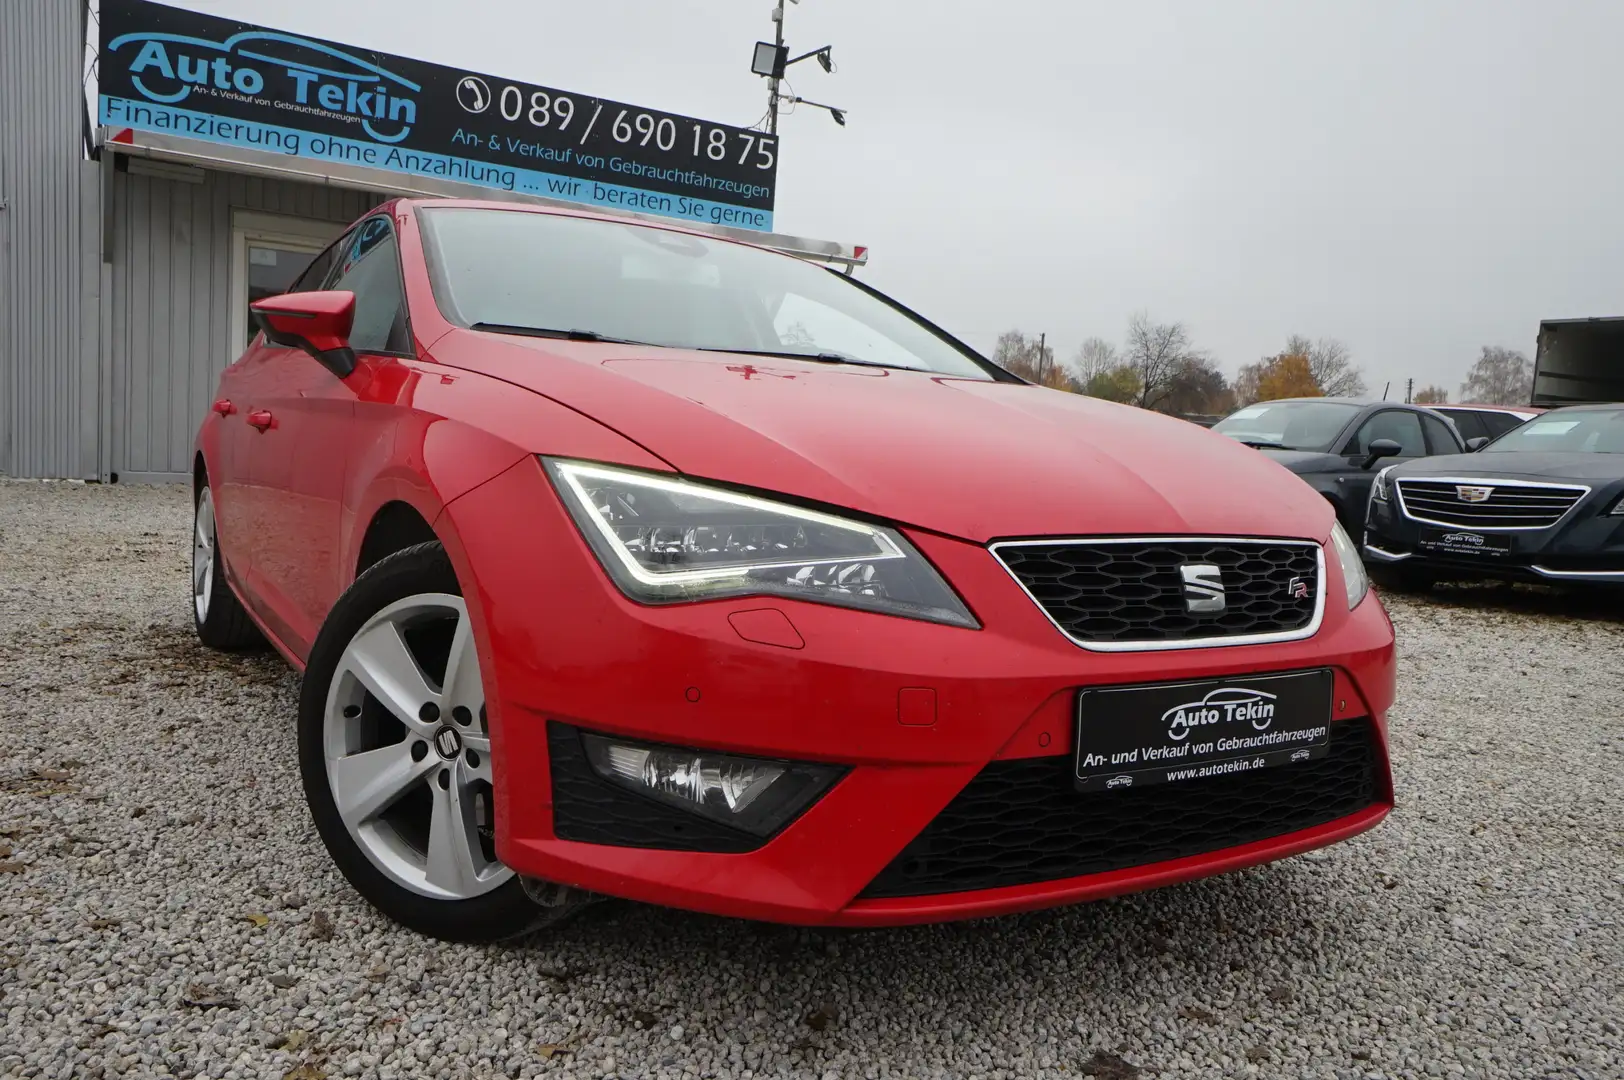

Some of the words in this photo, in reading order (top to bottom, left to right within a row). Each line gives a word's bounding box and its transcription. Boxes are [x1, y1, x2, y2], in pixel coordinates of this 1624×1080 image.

[128, 40, 264, 94] Auto
[287, 68, 417, 124] Tekin
[193, 84, 208, 94] An-
[211, 87, 218, 97] &
[220, 90, 253, 103] Verkauf
[254, 98, 271, 106] von
[274, 100, 361, 124] Gebrauchtfahrzeugen
[500, 86, 575, 131] 089
[611, 110, 676, 151] 690
[692, 124, 726, 161] 18
[736, 133, 775, 170] 75
[106, 97, 300, 156] Finanzierung
[310, 137, 377, 164] ohne
[385, 148, 516, 191] Anzahlung
[548, 176, 582, 196] wir
[592, 182, 671, 212] beraten
[678, 197, 704, 217] Sie
[710, 205, 765, 226] gerne
[452, 128, 484, 147] An-
[488, 134, 500, 150] &
[506, 137, 572, 163] Verkauf
[576, 153, 604, 169] von
[610, 156, 770, 199] Gebrauchtfahrzeugen
[1170, 708, 1218, 728] Auto
[1224, 701, 1274, 722] Tekin
[1083, 752, 1108, 768] An-
[1112, 749, 1138, 764] und
[1142, 743, 1190, 762] Verkauf
[1192, 740, 1214, 755] von
[1216, 725, 1326, 750] Gebrauchtfahrzeugen
[1166, 756, 1265, 782] www.autotekin.de
